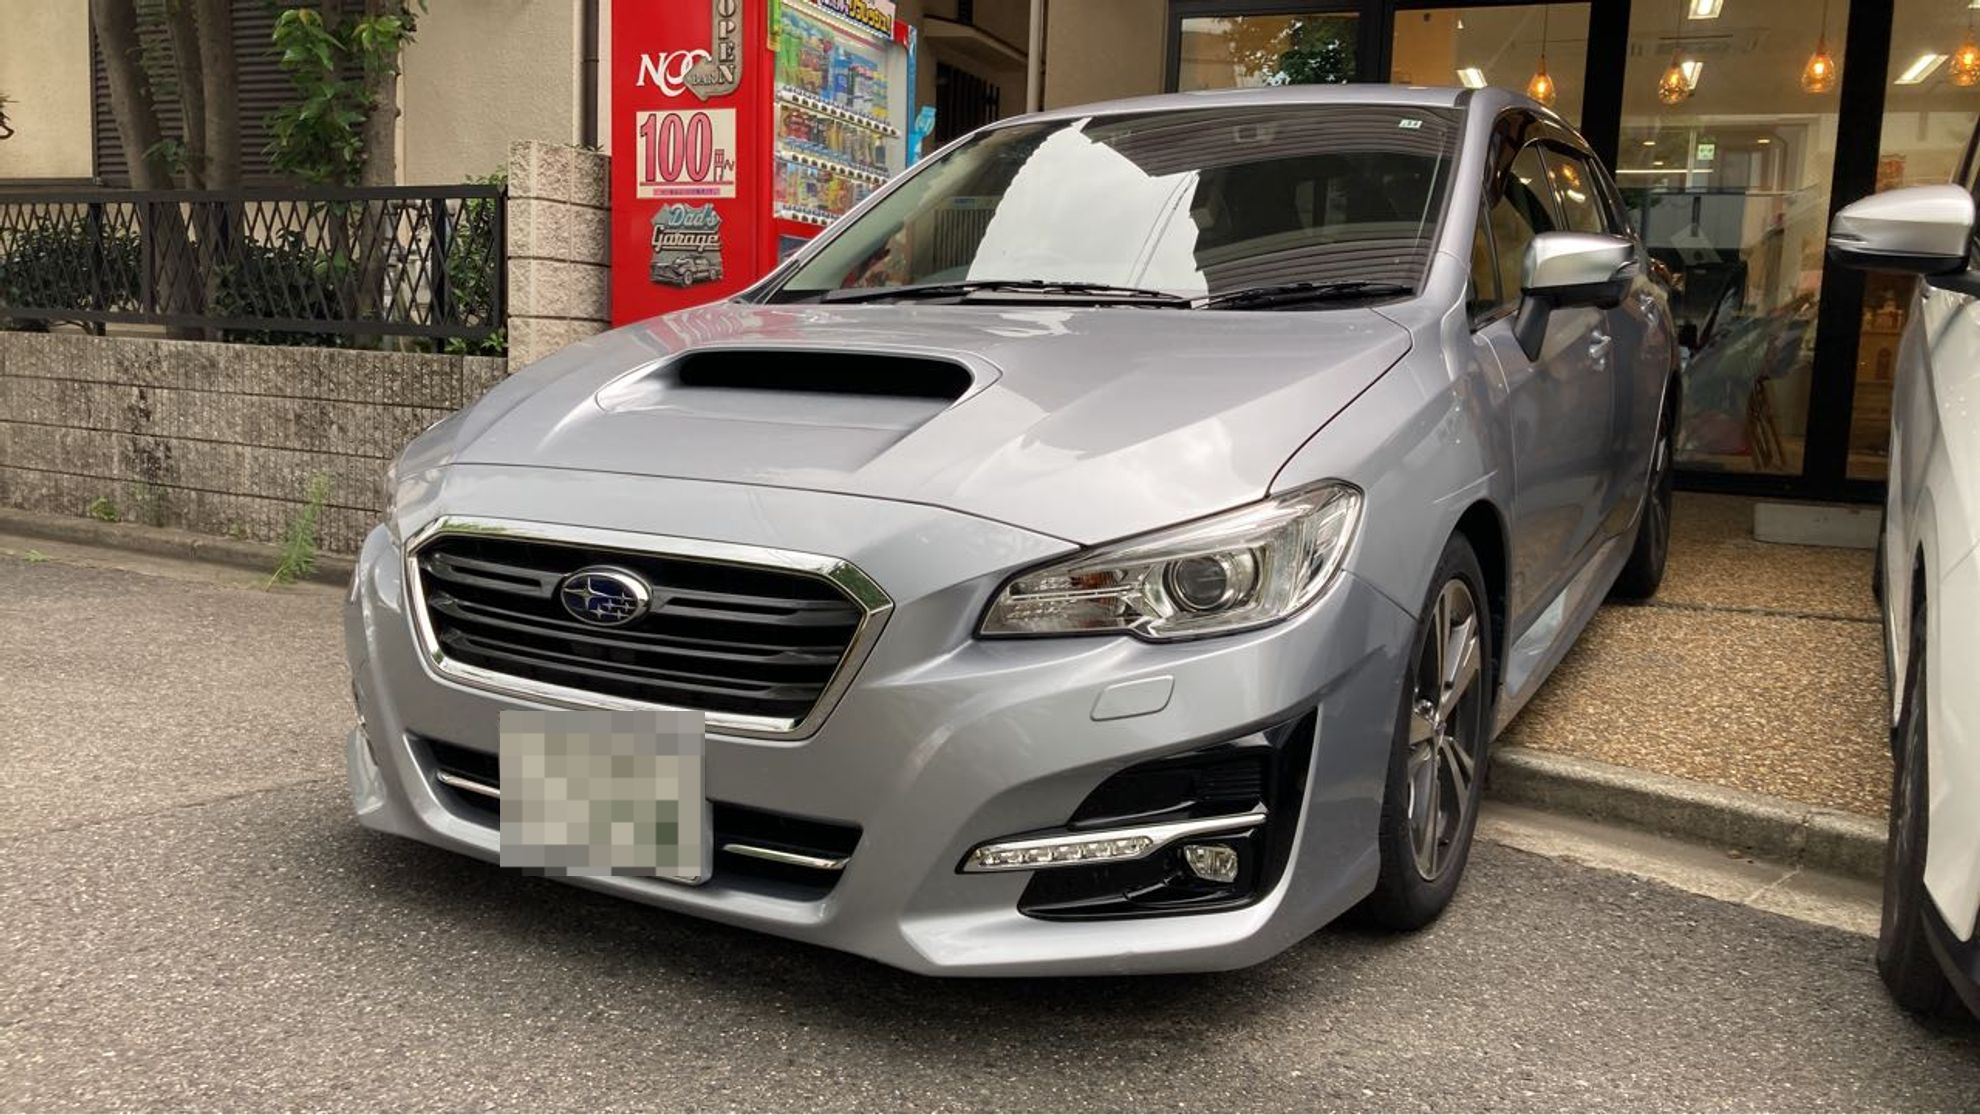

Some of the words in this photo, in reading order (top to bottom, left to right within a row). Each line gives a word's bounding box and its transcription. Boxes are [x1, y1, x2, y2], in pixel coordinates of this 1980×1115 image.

[717, 0, 736, 84] OPEN
[668, 203, 718, 227] Dad's
[651, 225, 721, 252] Garage
